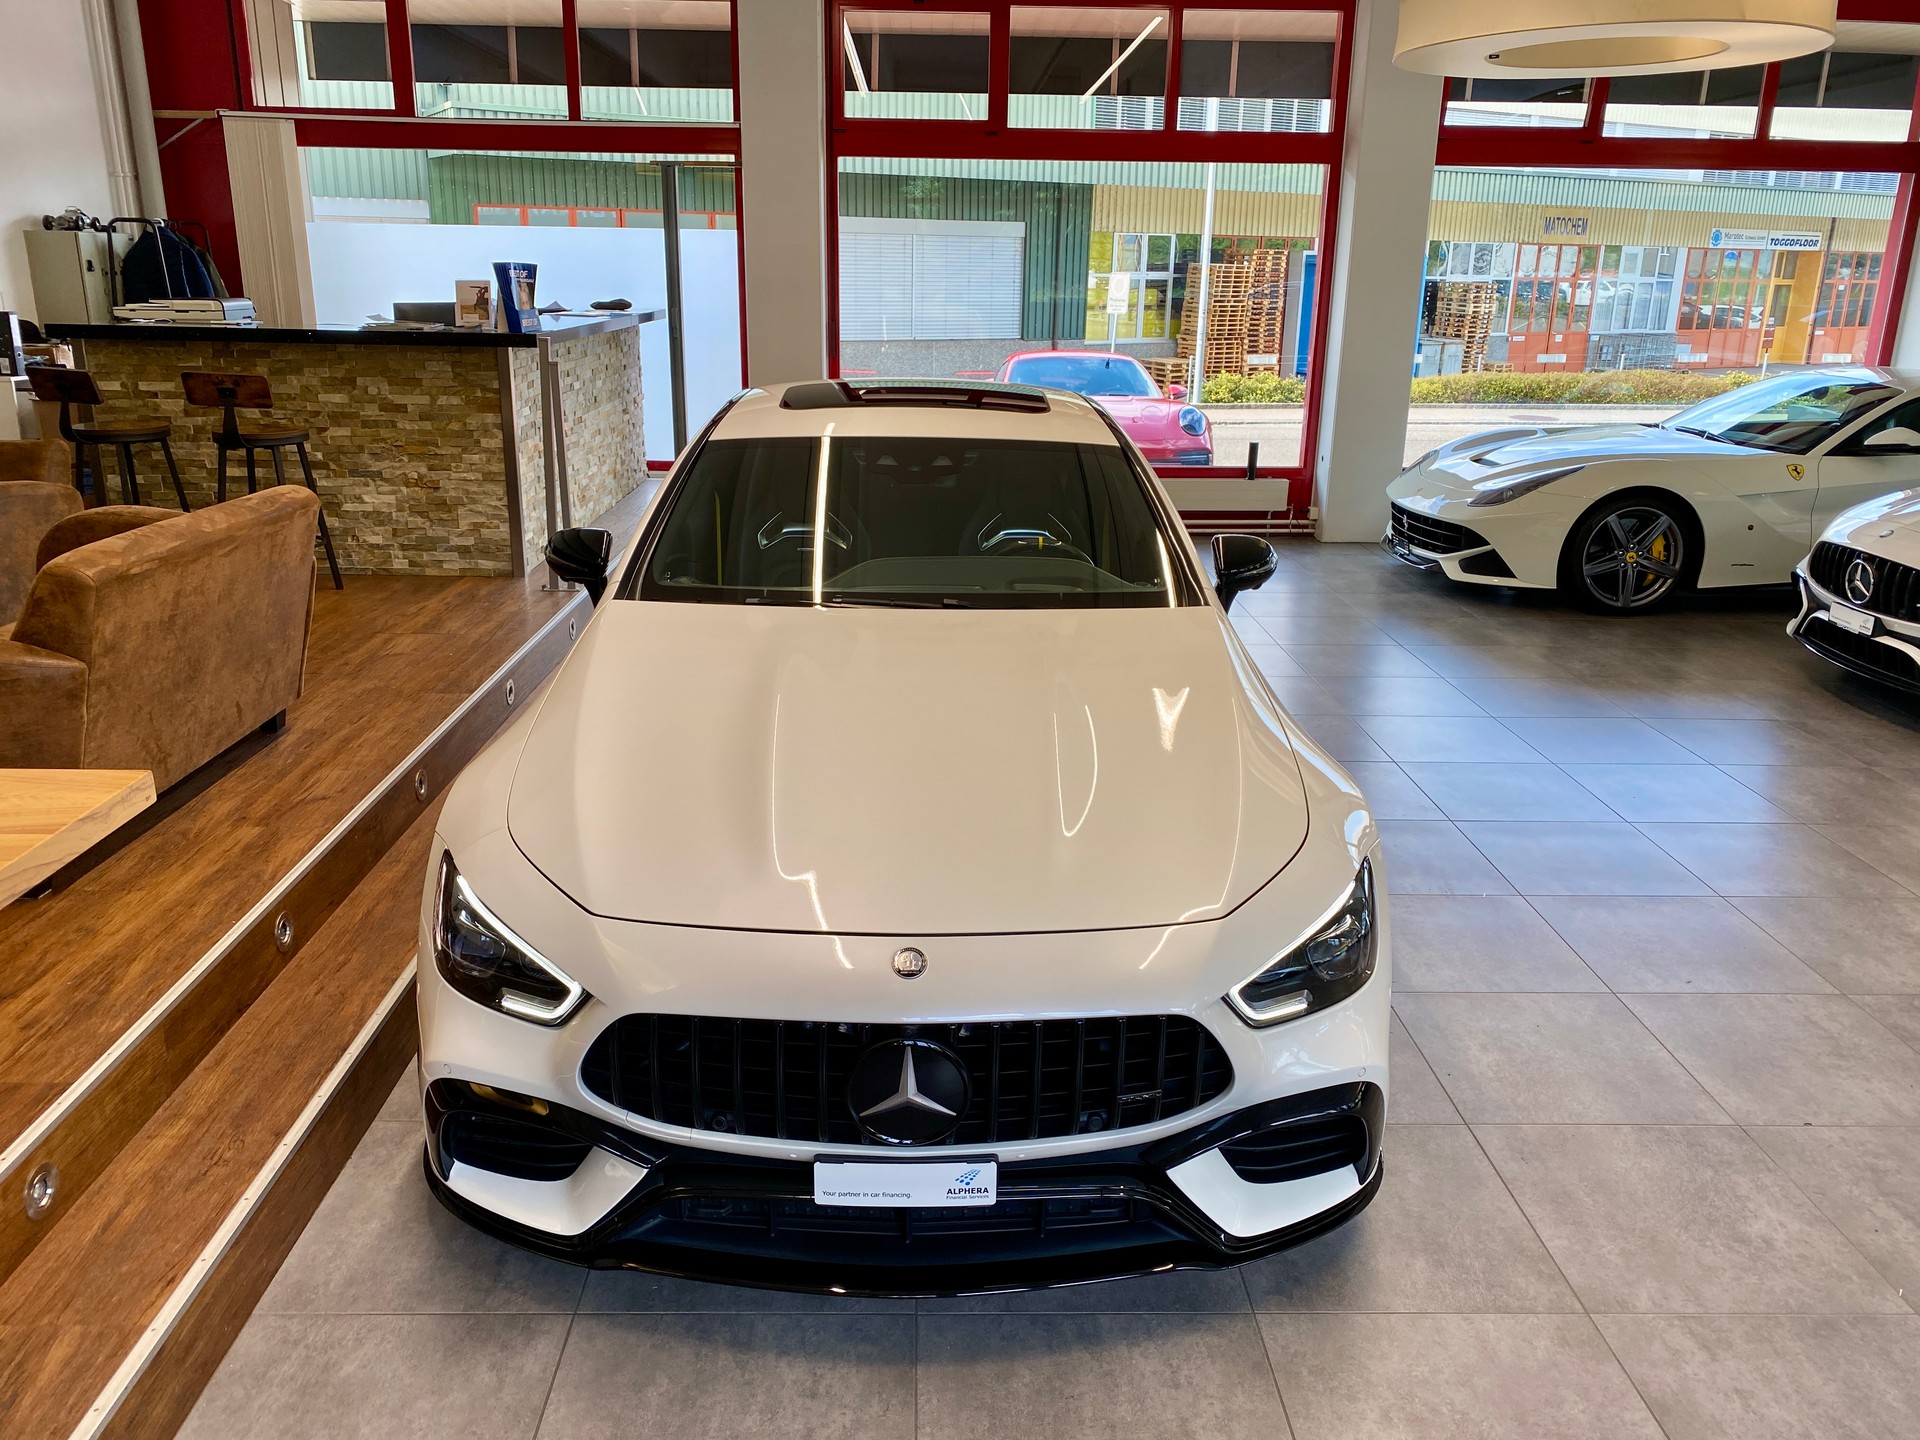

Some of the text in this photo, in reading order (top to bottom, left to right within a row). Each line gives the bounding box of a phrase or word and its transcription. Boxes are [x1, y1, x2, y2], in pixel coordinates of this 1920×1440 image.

[1543, 216, 1588, 235] MATOCHEM
[1770, 238, 1819, 247] TOGGOFLOOR
[946, 1187, 990, 1195] ALPHERA
[881, 1192, 913, 1200] financing.
